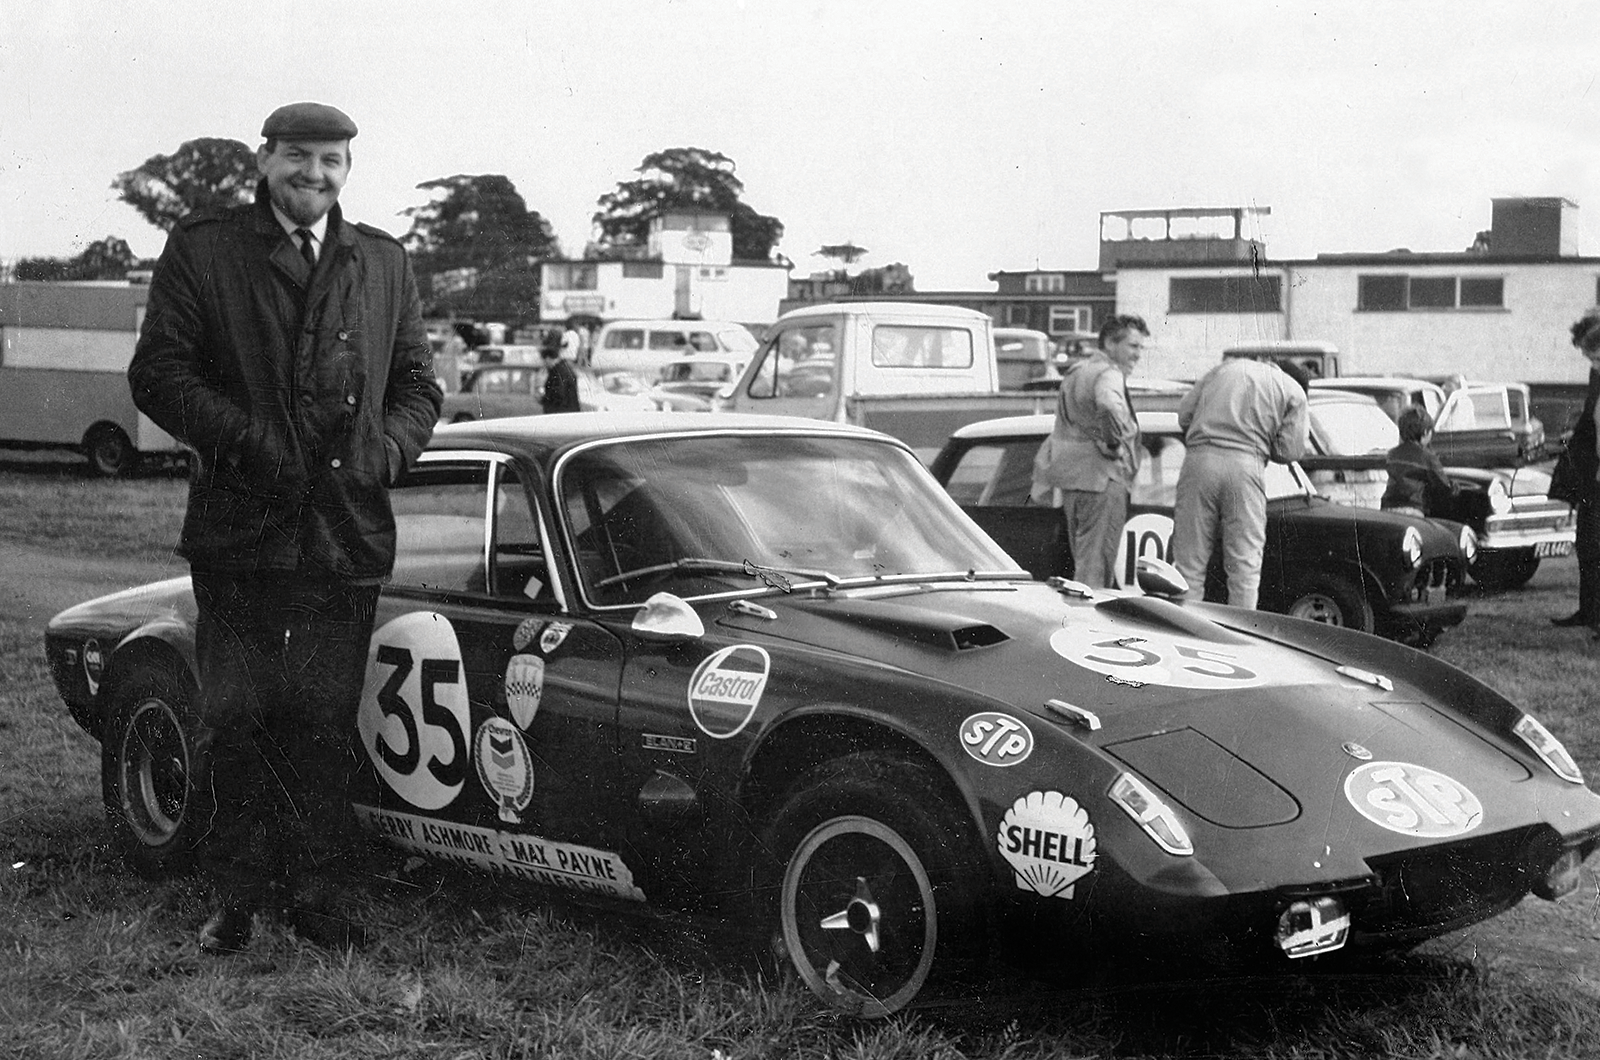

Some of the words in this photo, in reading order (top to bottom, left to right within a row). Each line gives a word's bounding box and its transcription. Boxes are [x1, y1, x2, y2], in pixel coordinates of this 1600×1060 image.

[1084, 631, 1257, 679] 35
[698, 672, 762, 700] Castrol
[375, 644, 467, 787] 35
[964, 718, 1026, 758] STP
[1367, 767, 1468, 828] STP
[422, 823, 494, 855] ASHMORE
[510, 840, 550, 867] MAX
[556, 848, 616, 880] PAYNE
[1006, 825, 1088, 867] SHELL
